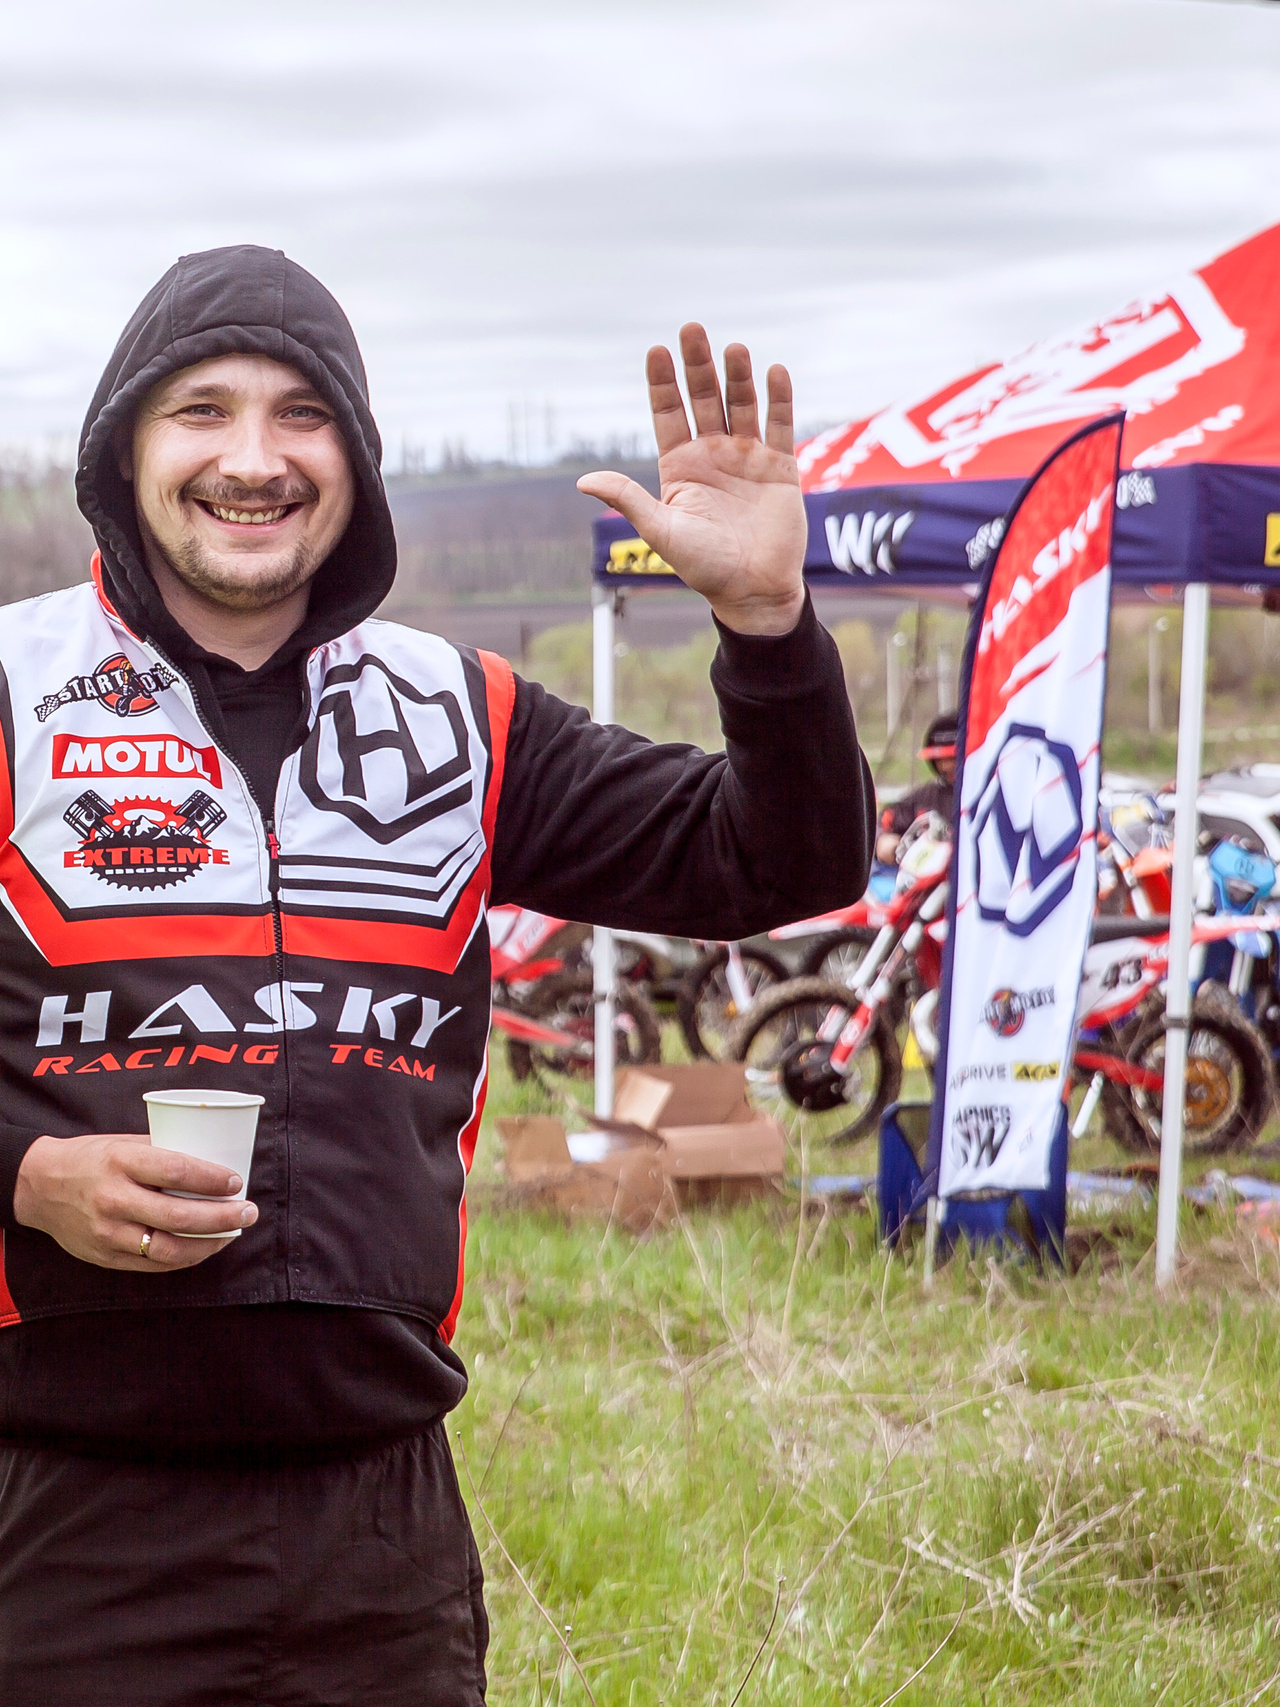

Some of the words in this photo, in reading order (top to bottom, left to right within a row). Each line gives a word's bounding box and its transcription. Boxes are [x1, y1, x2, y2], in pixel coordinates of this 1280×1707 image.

[61, 740, 212, 782] MOTUL
[63, 846, 231, 869] EXTREME
[35, 980, 462, 1049] HASKY
[32, 1043, 280, 1078] RACING
[328, 1043, 436, 1082] TEAM
